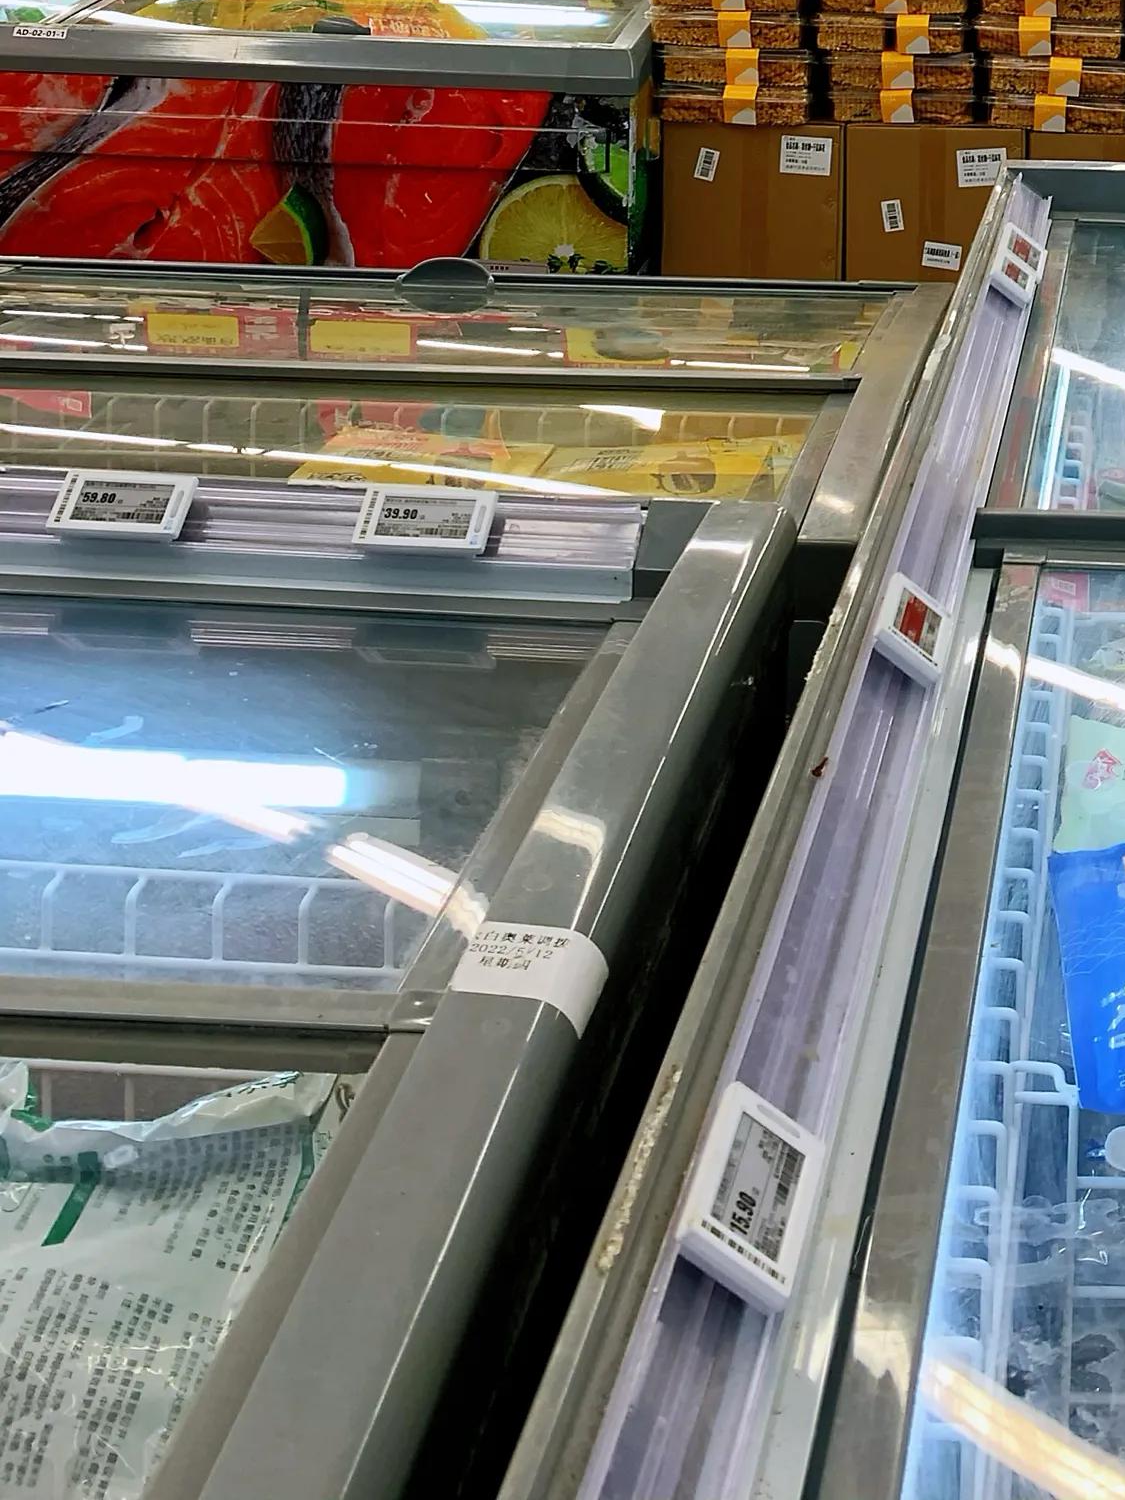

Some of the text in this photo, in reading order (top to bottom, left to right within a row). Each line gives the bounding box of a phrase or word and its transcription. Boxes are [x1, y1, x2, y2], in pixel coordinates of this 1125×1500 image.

[15, 27, 66, 39] AD-02-01-1
[383, 507, 419, 520] 39.90
[469, 943, 554, 960] 2022/5/12
[729, 1191, 758, 1237] 15.90
